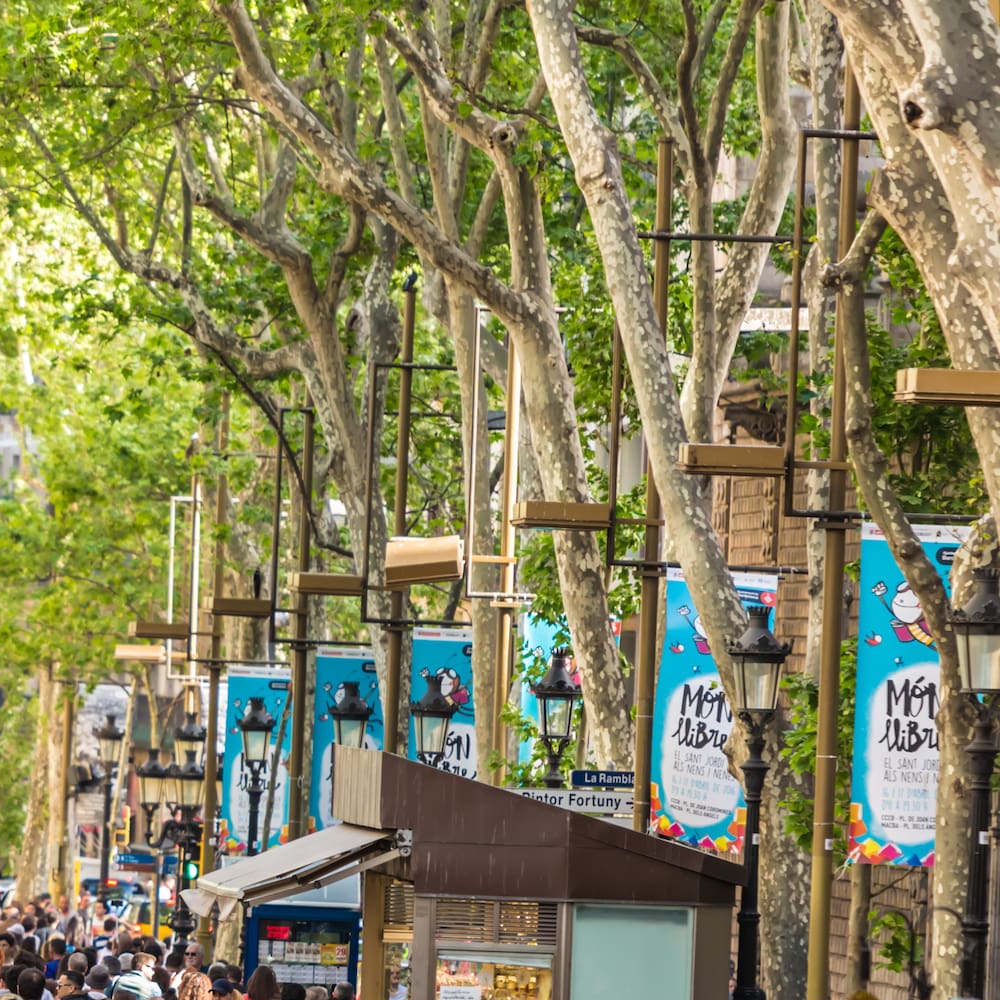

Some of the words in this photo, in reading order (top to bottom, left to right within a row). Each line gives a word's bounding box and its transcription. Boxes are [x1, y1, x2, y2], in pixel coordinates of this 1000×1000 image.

[884, 757, 892, 769] EL
[897, 758, 917, 770] SANT
[584, 772, 597, 783] La
[884, 770, 897, 782] ALS
[900, 771, 922, 783] NENS
[569, 793, 621, 811] Fortuny
